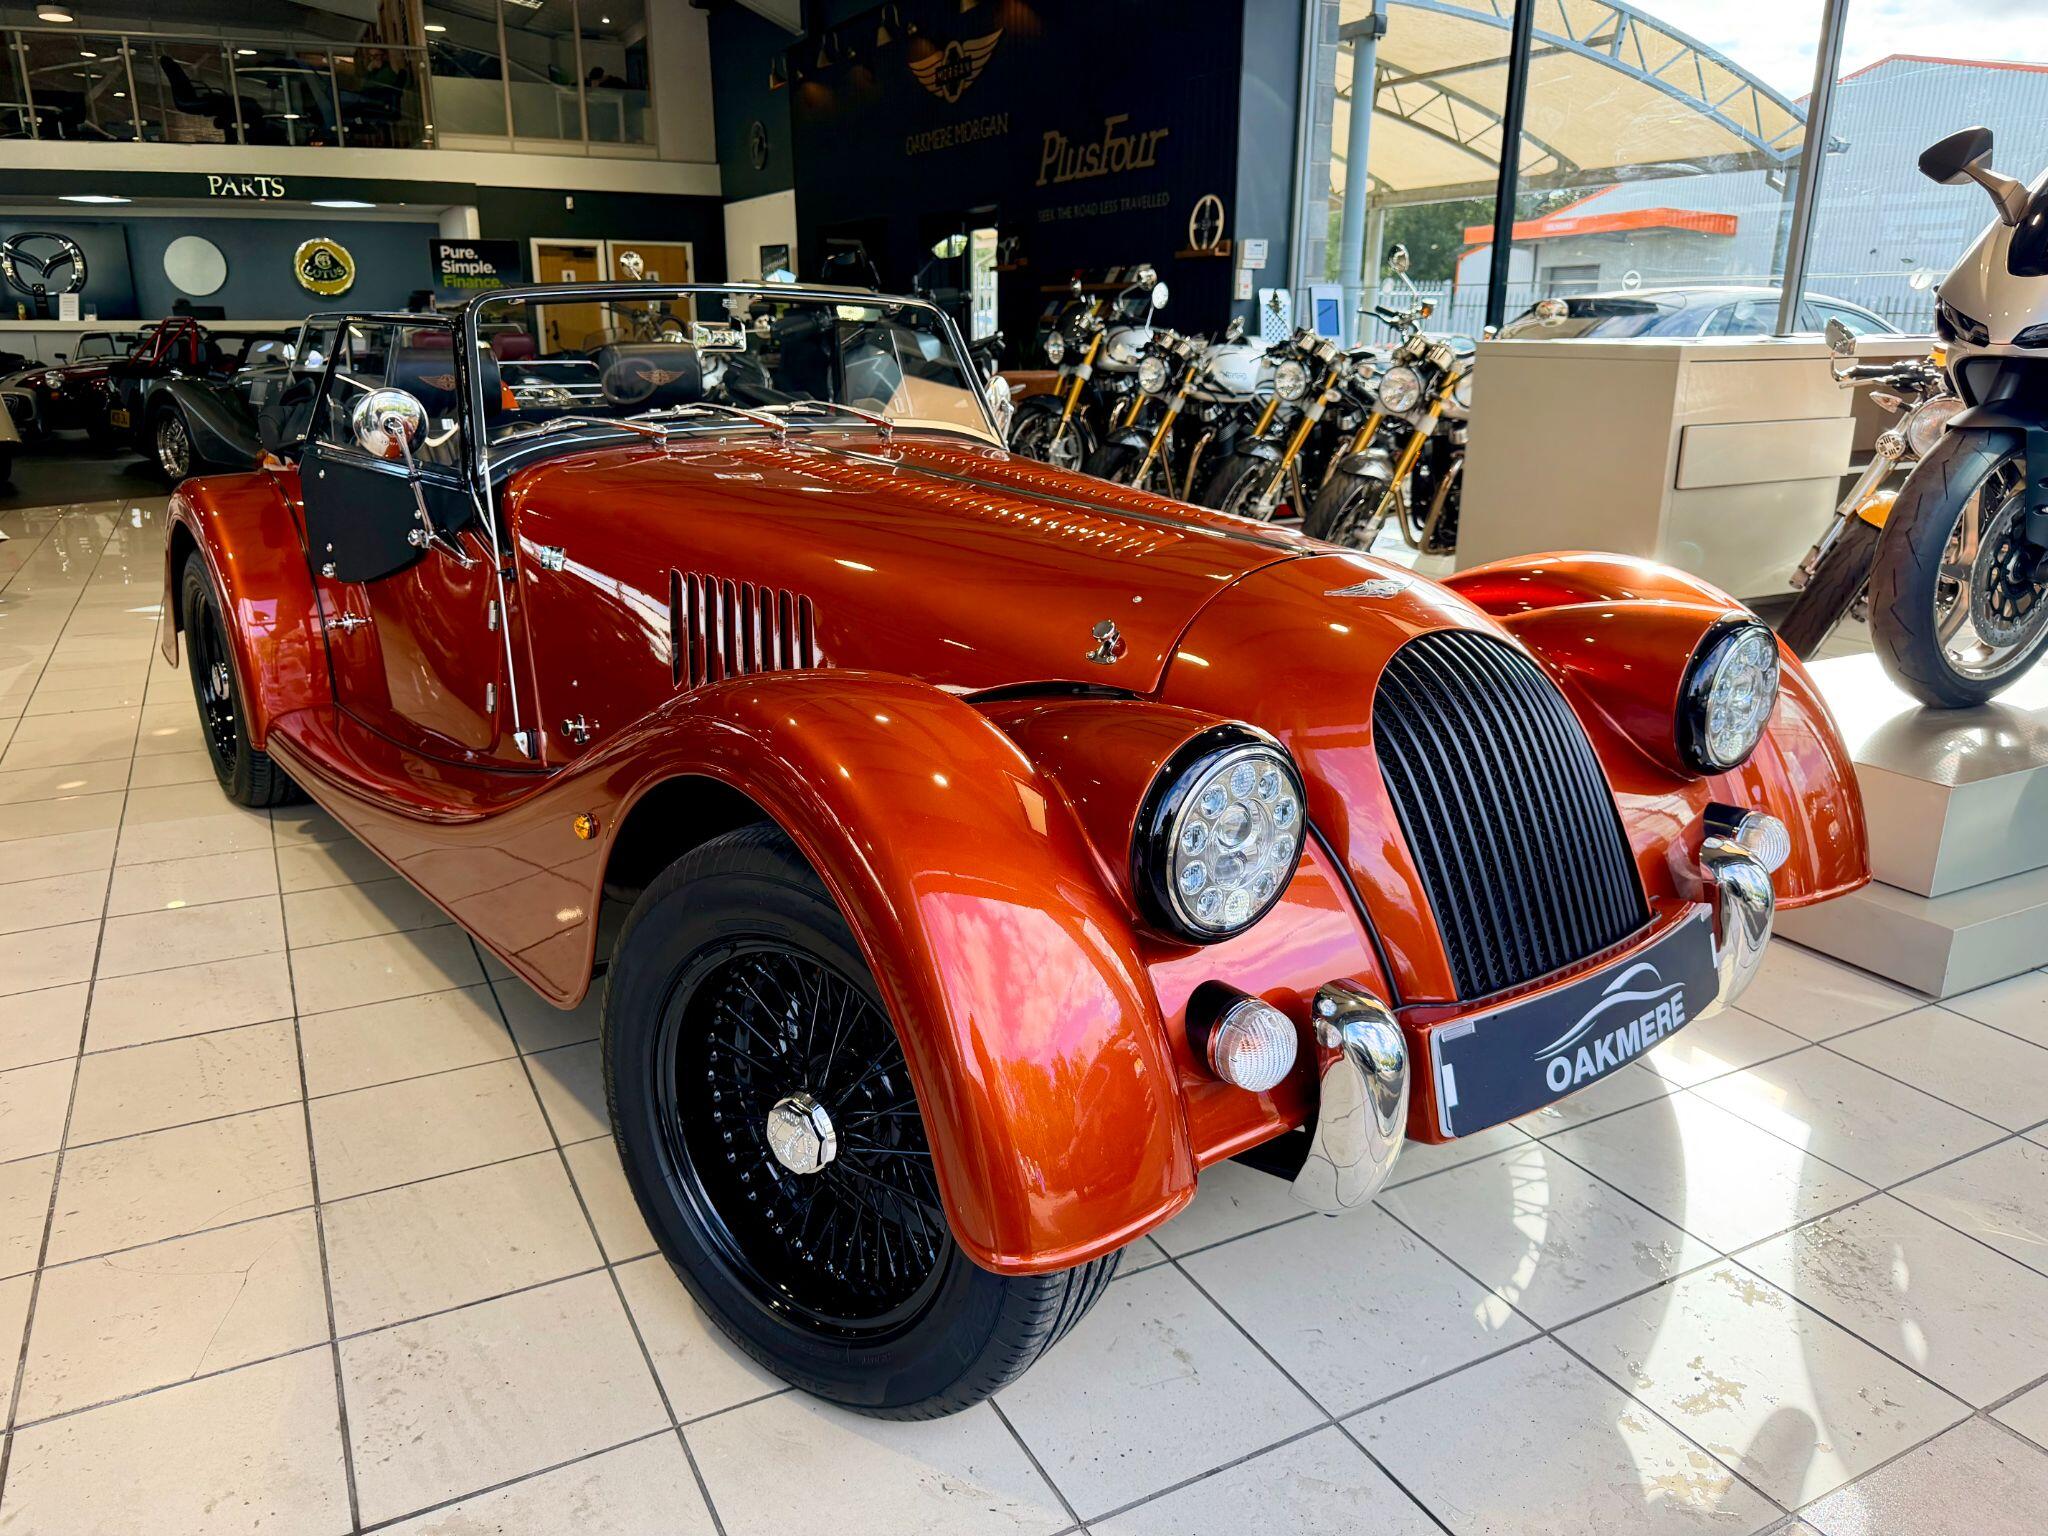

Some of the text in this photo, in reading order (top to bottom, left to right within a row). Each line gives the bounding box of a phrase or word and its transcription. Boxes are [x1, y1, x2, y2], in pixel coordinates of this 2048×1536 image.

[954, 112, 1008, 144] MORGAN
[207, 175, 285, 197] PARTS
[1057, 206, 1072, 220] THE
[1073, 202, 1098, 218] ROAD
[1099, 199, 1118, 215] LESS
[1119, 192, 1170, 211] TRAVELLED
[440, 245, 478, 259] Pure.
[304, 265, 345, 279] LOTUS
[441, 260, 496, 276] Simple.
[1546, 991, 1686, 1093] OAKMERE
